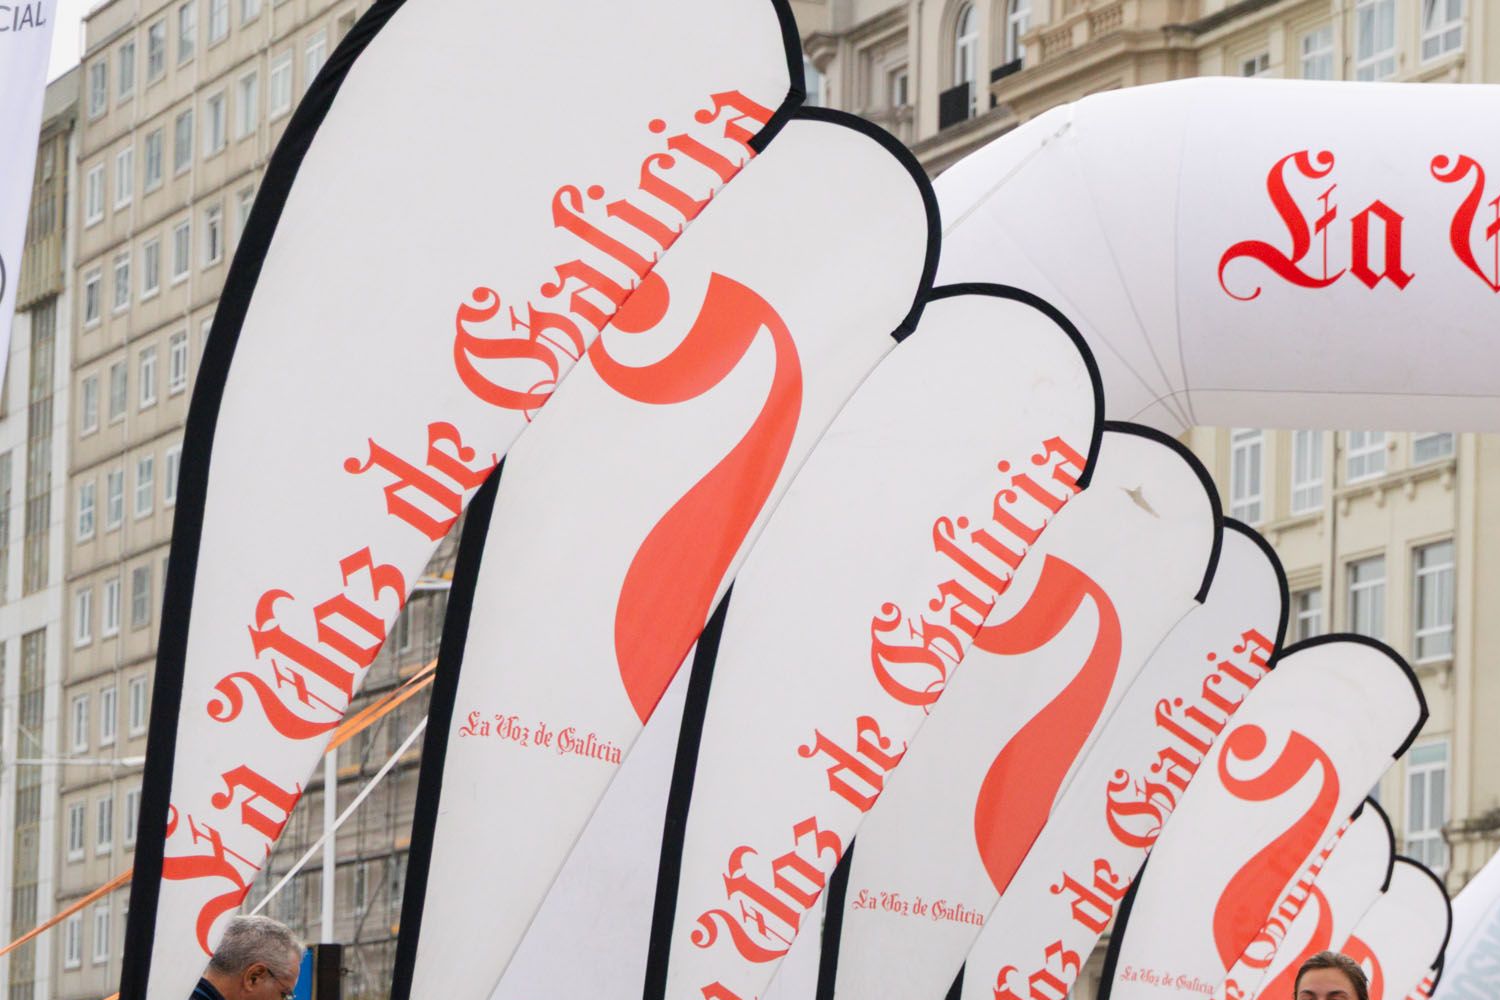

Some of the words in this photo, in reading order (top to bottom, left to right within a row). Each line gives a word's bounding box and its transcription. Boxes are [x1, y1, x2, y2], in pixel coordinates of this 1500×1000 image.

[1217, 149, 1415, 301] La
[207, 547, 407, 739] Voz
[344, 421, 502, 541] de
[454, 90, 777, 422] Galicia
[459, 711, 490, 737] La
[495, 713, 529, 747] Voz
[534, 721, 553, 748] de
[557, 727, 623, 765] Galicia
[691, 816, 842, 963] Voz
[798, 716, 907, 812] de
[871, 436, 1090, 716] Galicia
[1050, 858, 1134, 935] de
[1106, 628, 1275, 855] Galicia
[852, 889, 877, 910] La
[880, 891, 909, 916] Voz
[913, 896, 928, 916] de
[931, 899, 985, 927] Galicia
